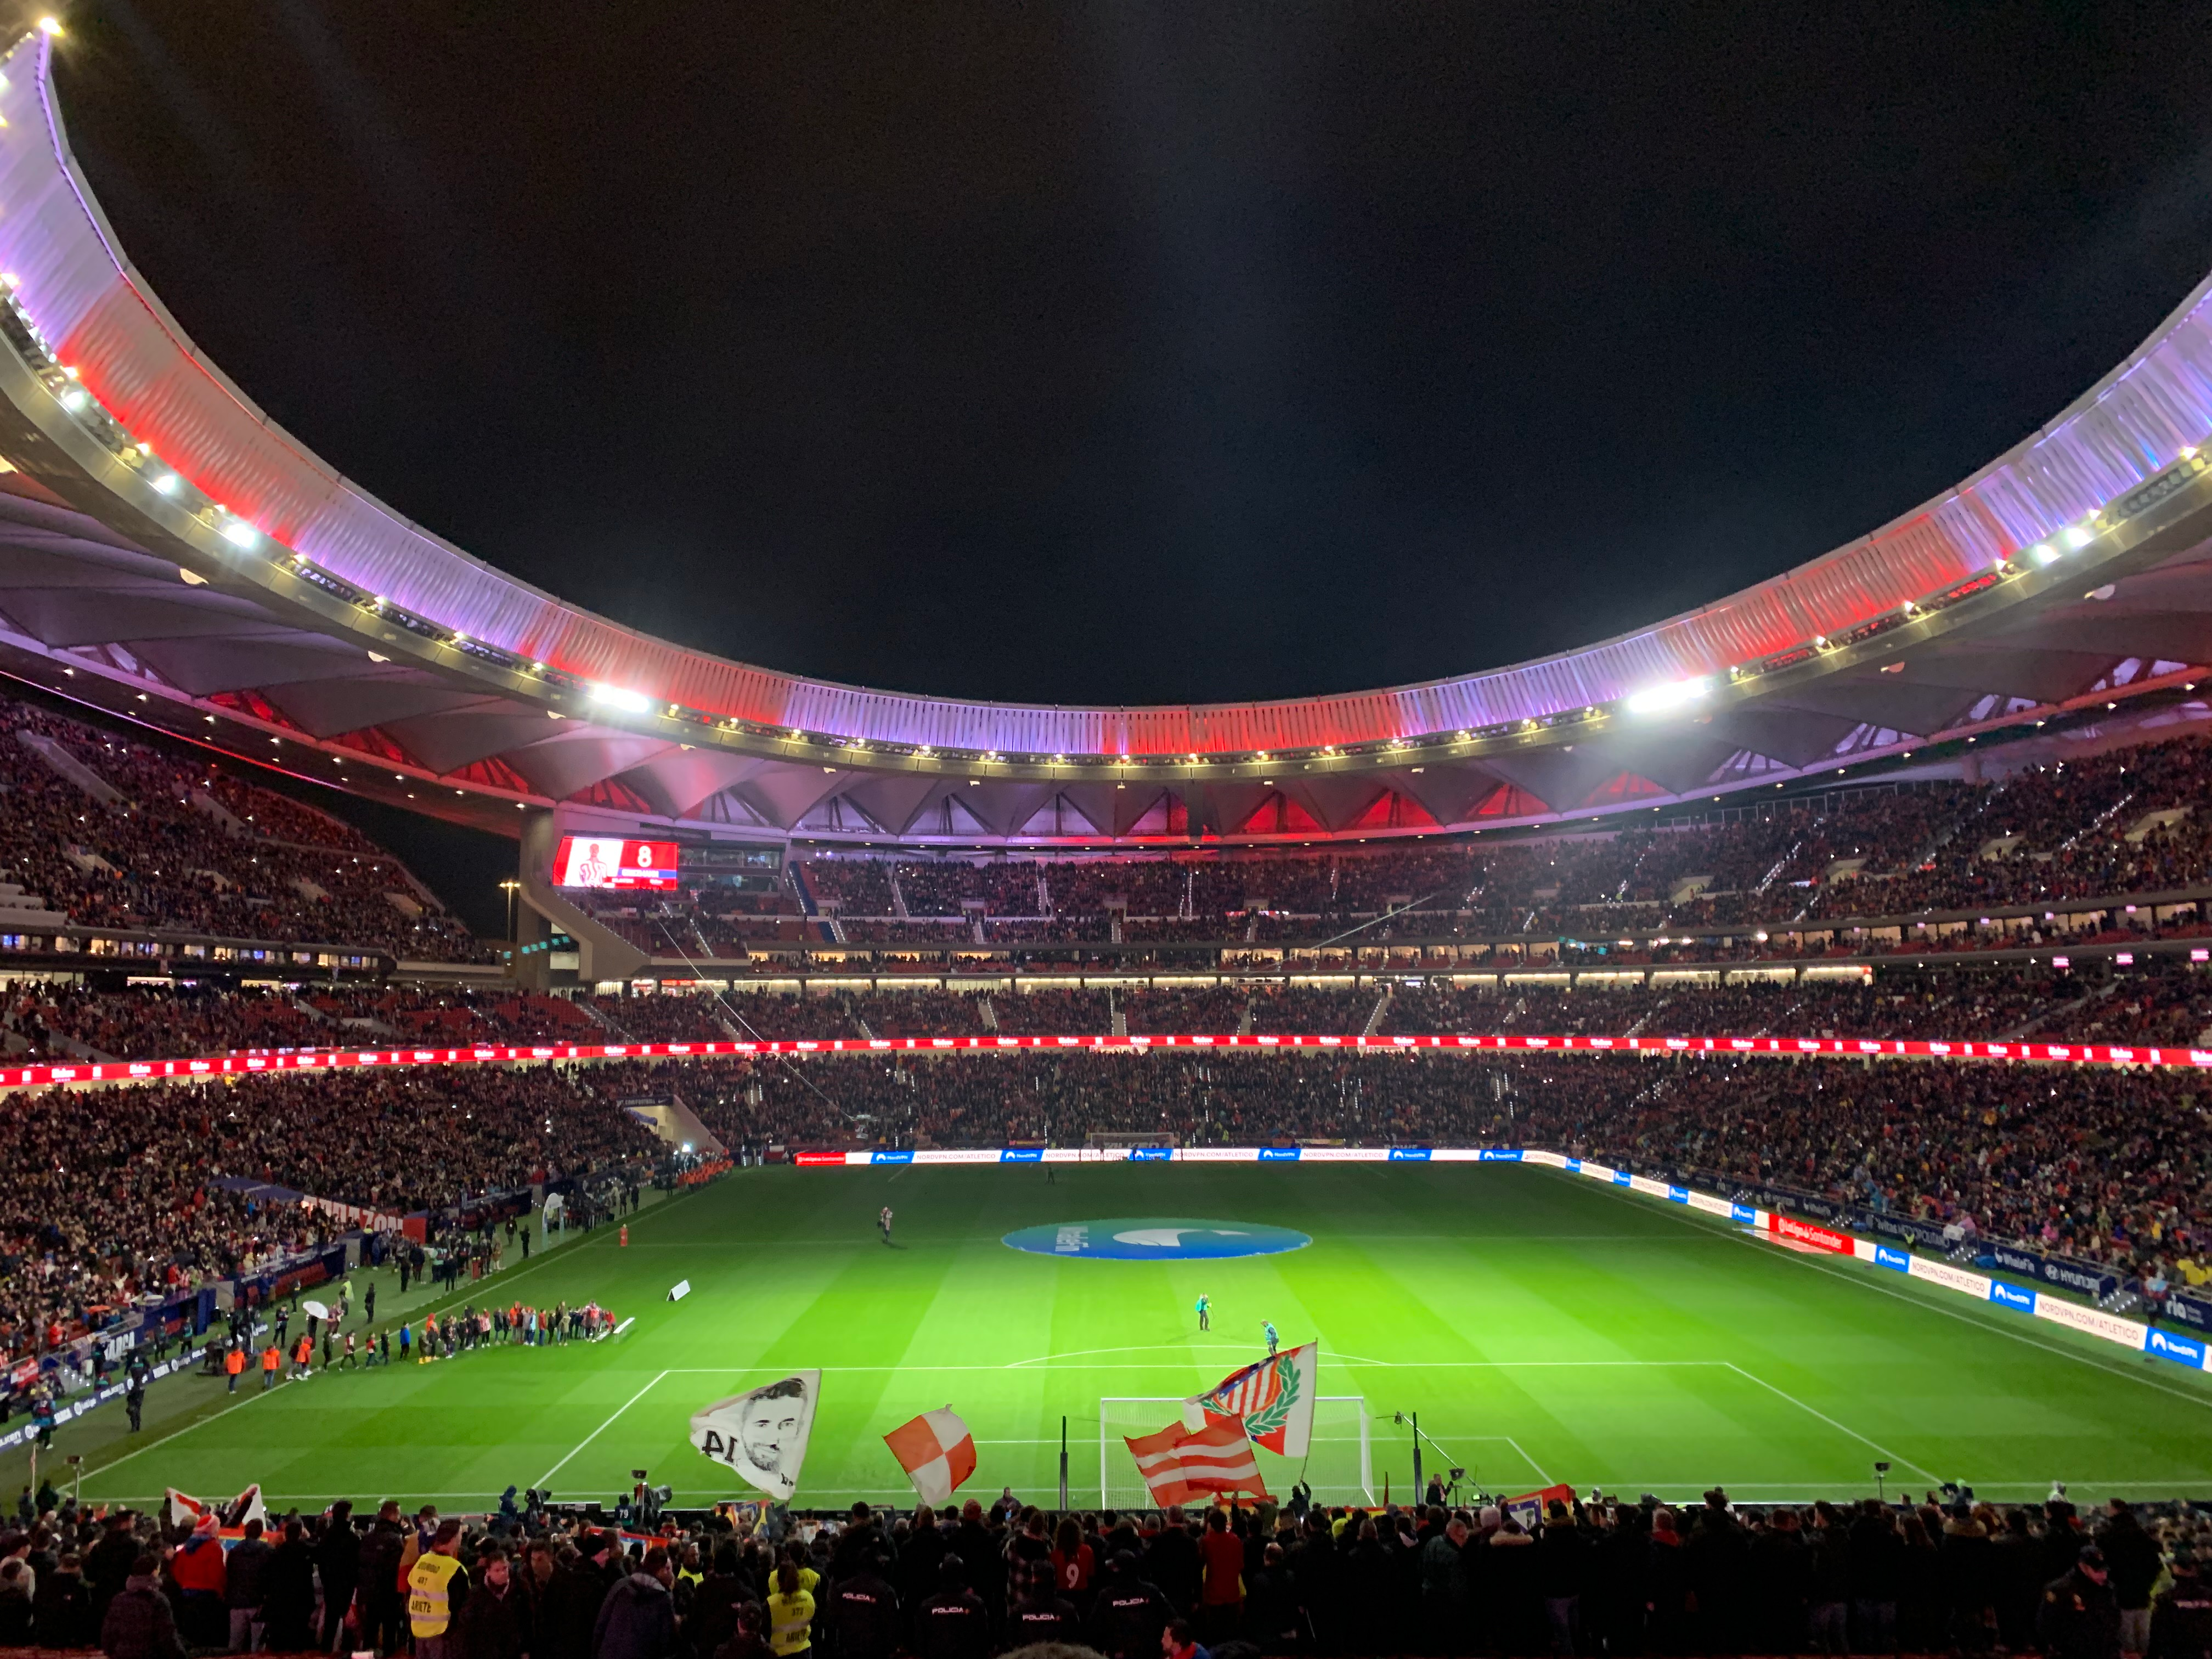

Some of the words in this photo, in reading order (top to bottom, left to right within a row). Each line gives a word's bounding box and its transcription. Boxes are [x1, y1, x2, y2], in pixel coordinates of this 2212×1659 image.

[637, 845, 652, 867] 8
[1809, 1227, 1842, 1250] Santander
[1912, 1262, 1985, 1293] NORDVPN.COM/ATLETICO
[2039, 1300, 2139, 1342] NORDVPN.COM/ATLETICO
[619, 1509, 629, 1519] 79
[1066, 1563, 1079, 1589] 9
[932, 1606, 963, 1615] POLICIA
[1113, 1598, 1144, 1606] POLICIA
[1022, 1613, 1054, 1621] POLICIA
